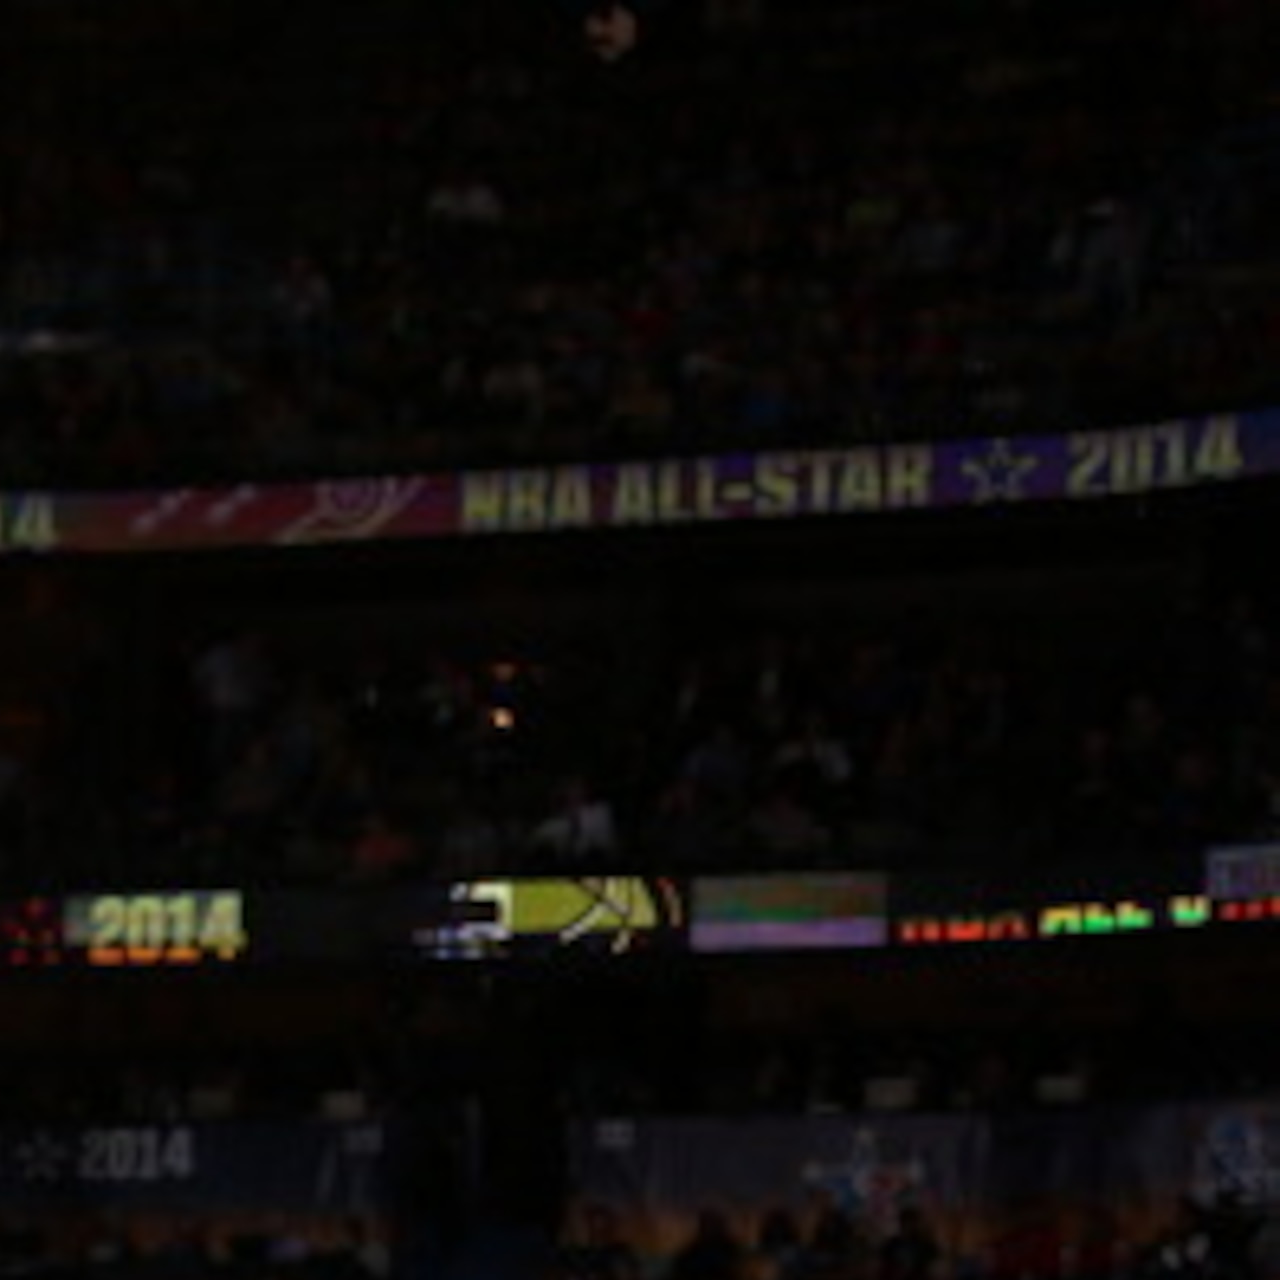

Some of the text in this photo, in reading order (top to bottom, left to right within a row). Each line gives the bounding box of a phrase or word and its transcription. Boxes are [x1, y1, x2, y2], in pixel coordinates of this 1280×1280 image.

[462, 419, 1243, 532] NBA ALL-STAR 2014
[80, 1128, 196, 1178] 2014
